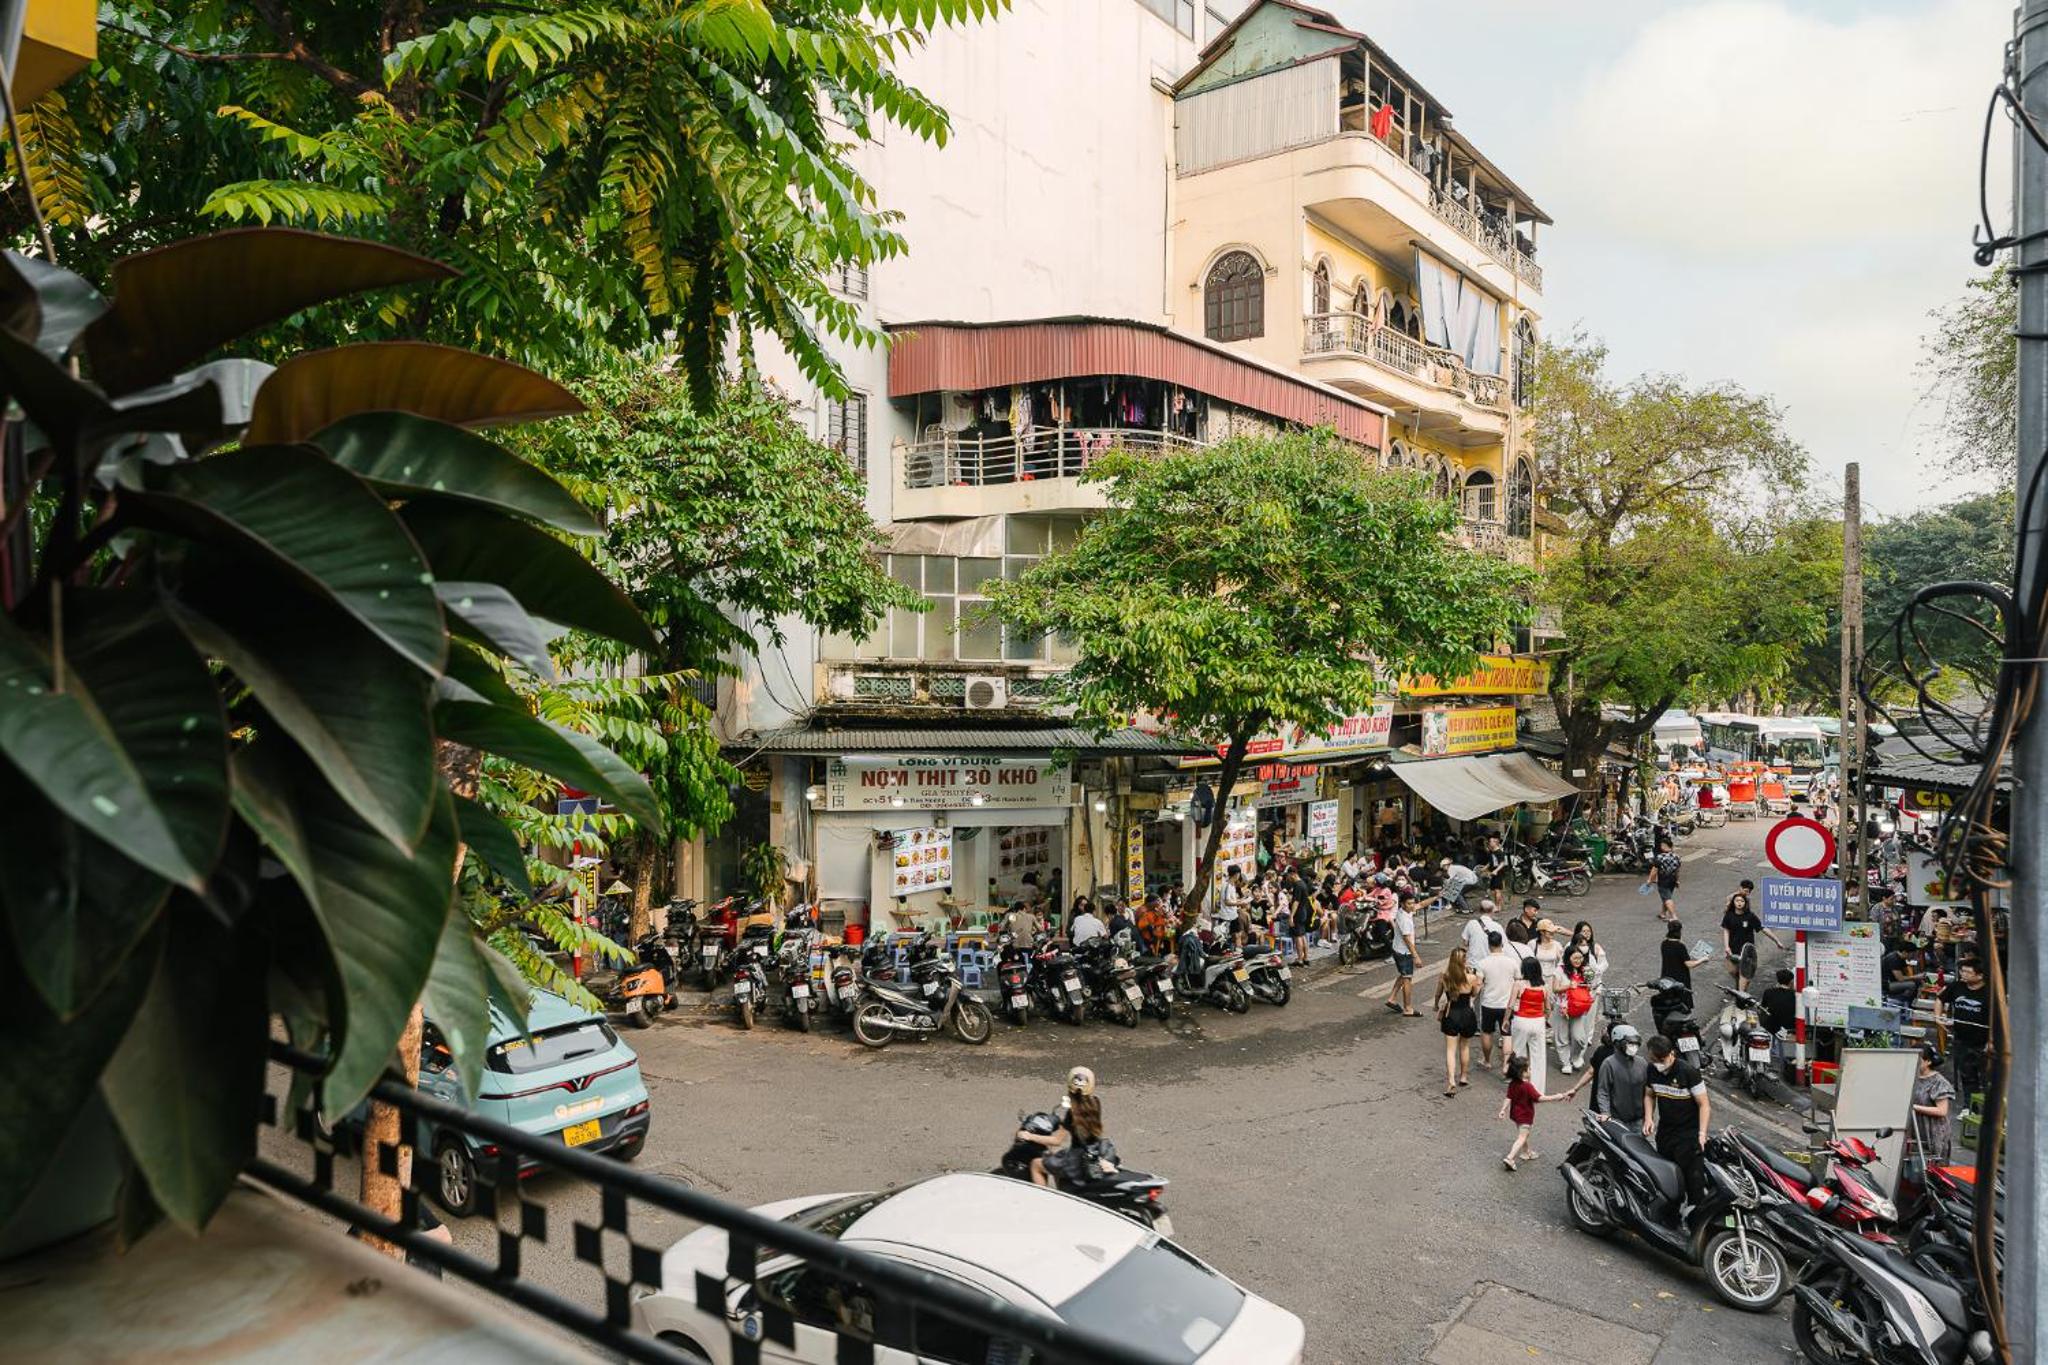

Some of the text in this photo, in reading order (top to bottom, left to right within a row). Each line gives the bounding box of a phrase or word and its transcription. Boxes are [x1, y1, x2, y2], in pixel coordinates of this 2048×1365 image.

[898, 757, 938, 767] LONG
[861, 767, 909, 789] NỘM
[915, 769, 959, 788] THỊT
[998, 765, 1038, 785] KHÔ
[921, 789, 939, 797] GIA
[1769, 881, 1795, 897] TUYẾN
[1796, 883, 1813, 898] PHỐ
